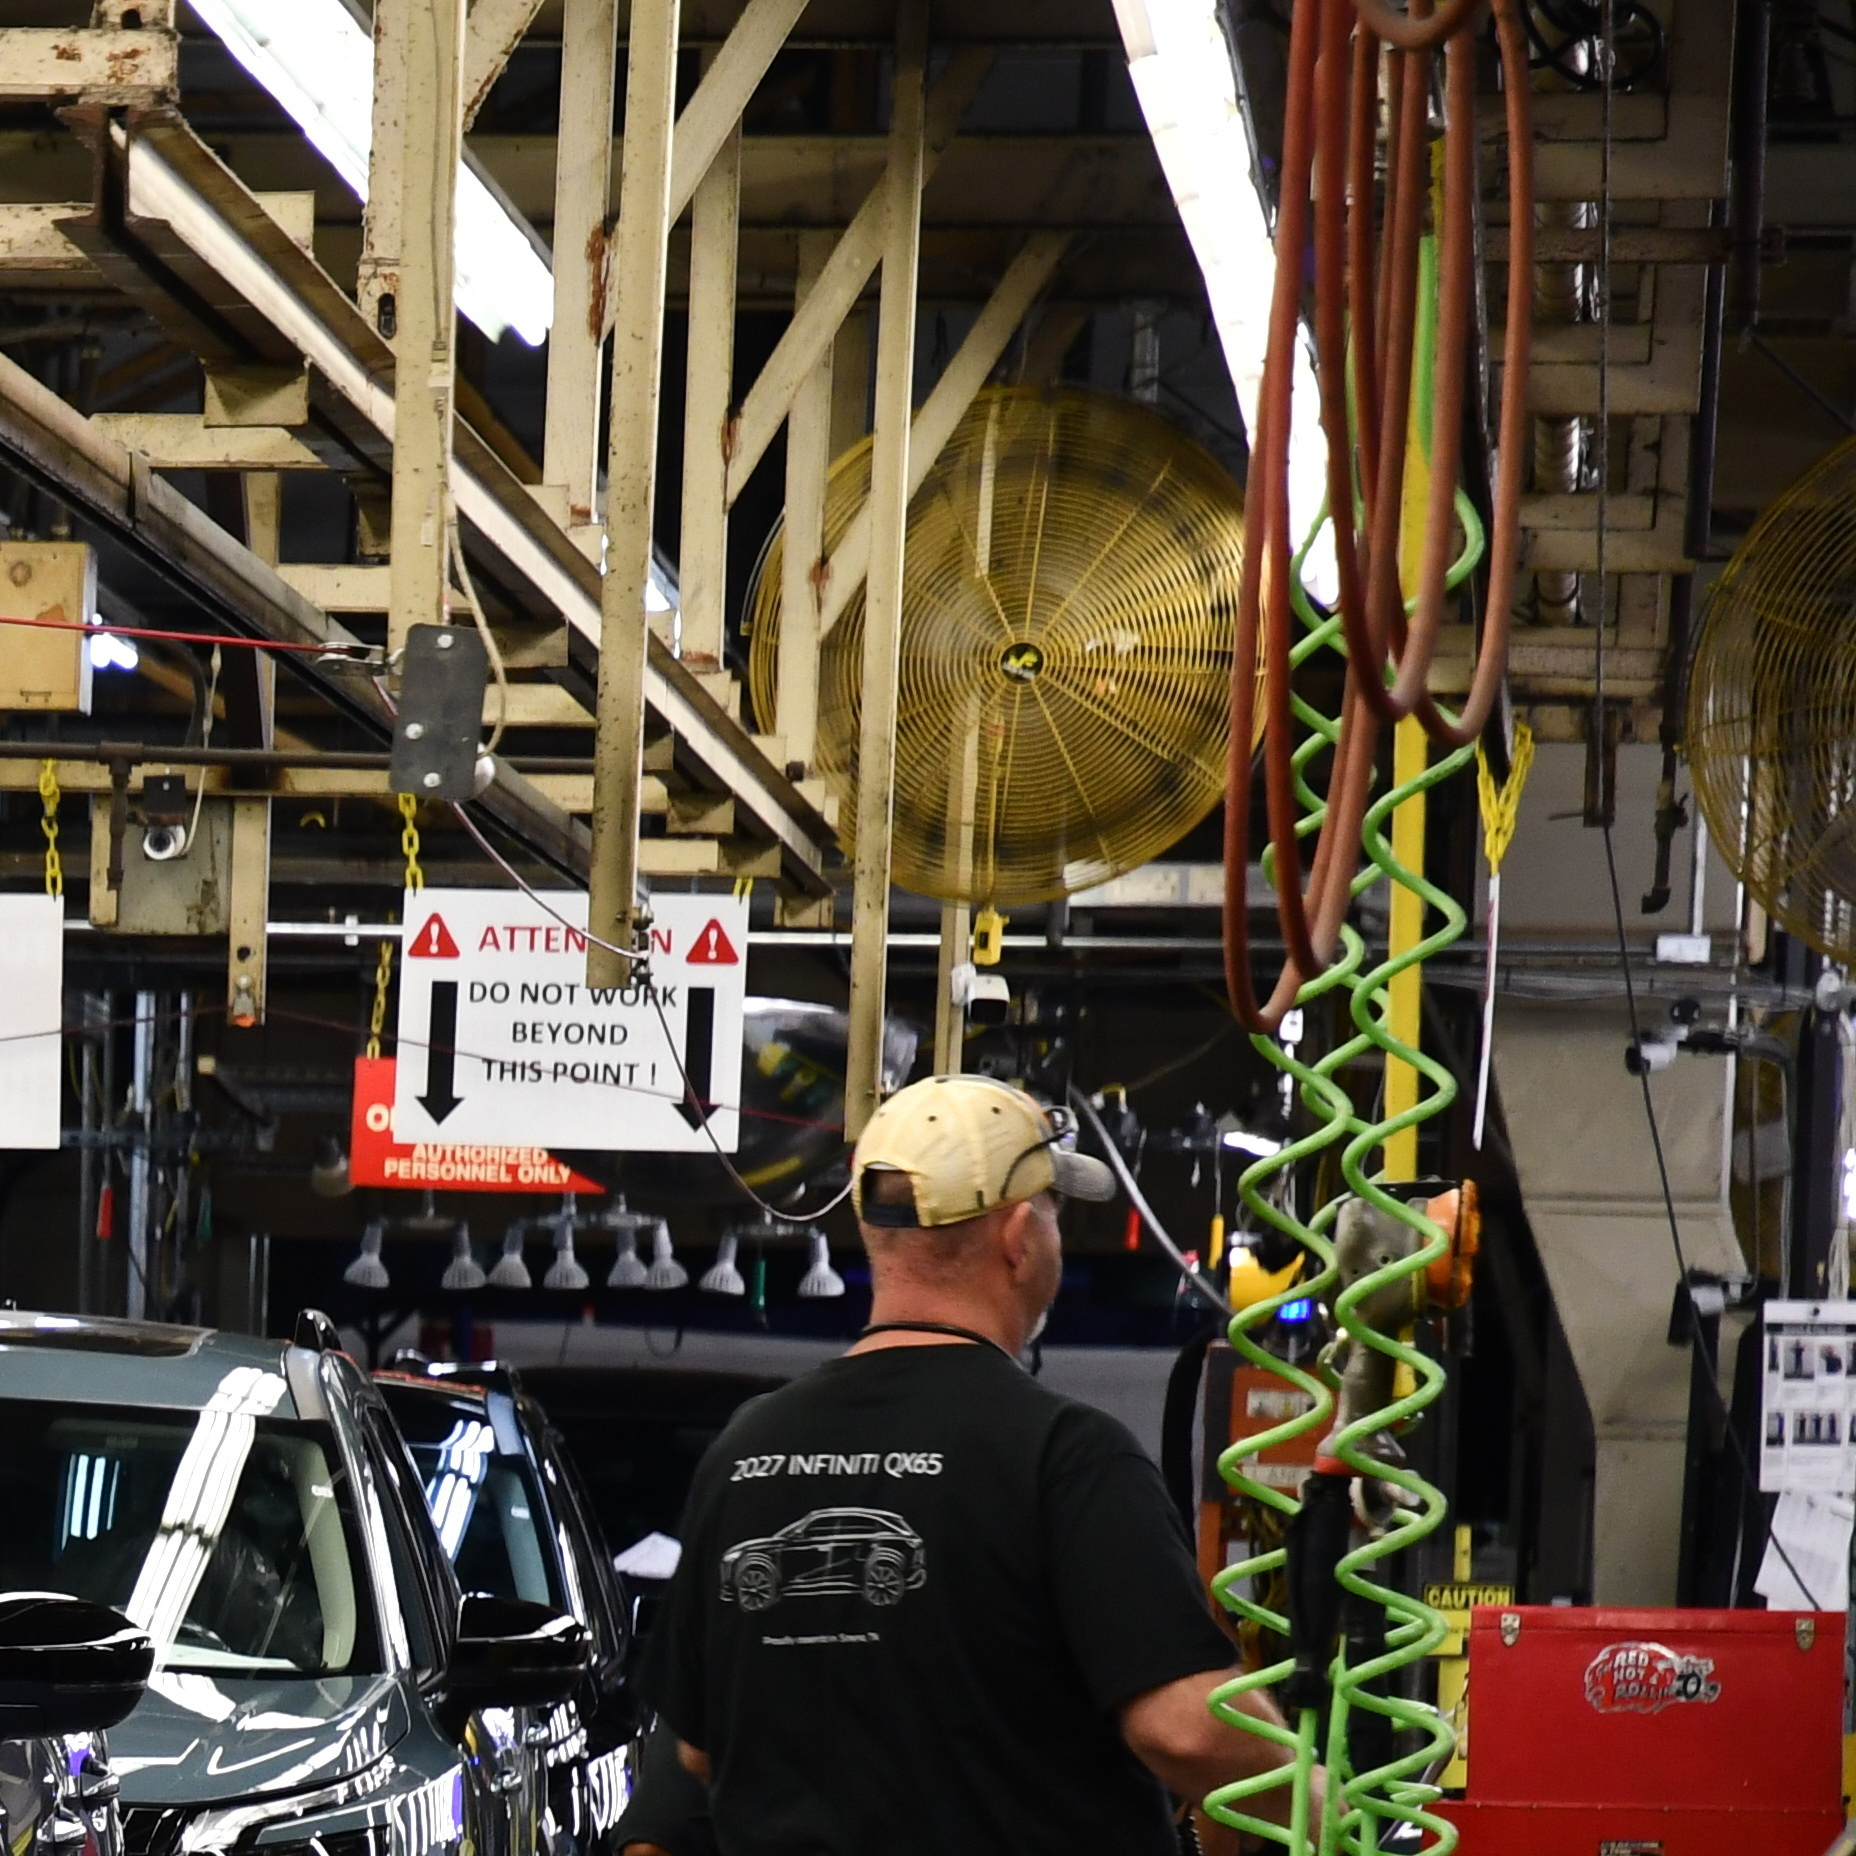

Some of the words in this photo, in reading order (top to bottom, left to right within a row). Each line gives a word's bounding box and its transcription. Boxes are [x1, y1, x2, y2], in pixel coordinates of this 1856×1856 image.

[478, 925, 673, 954] ATTENN
[468, 980, 510, 1004] DO
[520, 982, 581, 1006] NOT
[589, 984, 678, 1008] WORK
[512, 1021, 629, 1046] BEYOND
[482, 1058, 543, 1083] THIS
[553, 1061, 640, 1085] POINT
[411, 1144, 550, 1167] AUTHORIZED
[384, 1156, 513, 1184] PERSONNEL
[517, 1164, 572, 1185] ONLY
[729, 1454, 786, 1482] 2027
[787, 1453, 881, 1476] INFINITI
[883, 1451, 945, 1479] QX65
[1427, 1586, 1512, 1609] CAUTION
